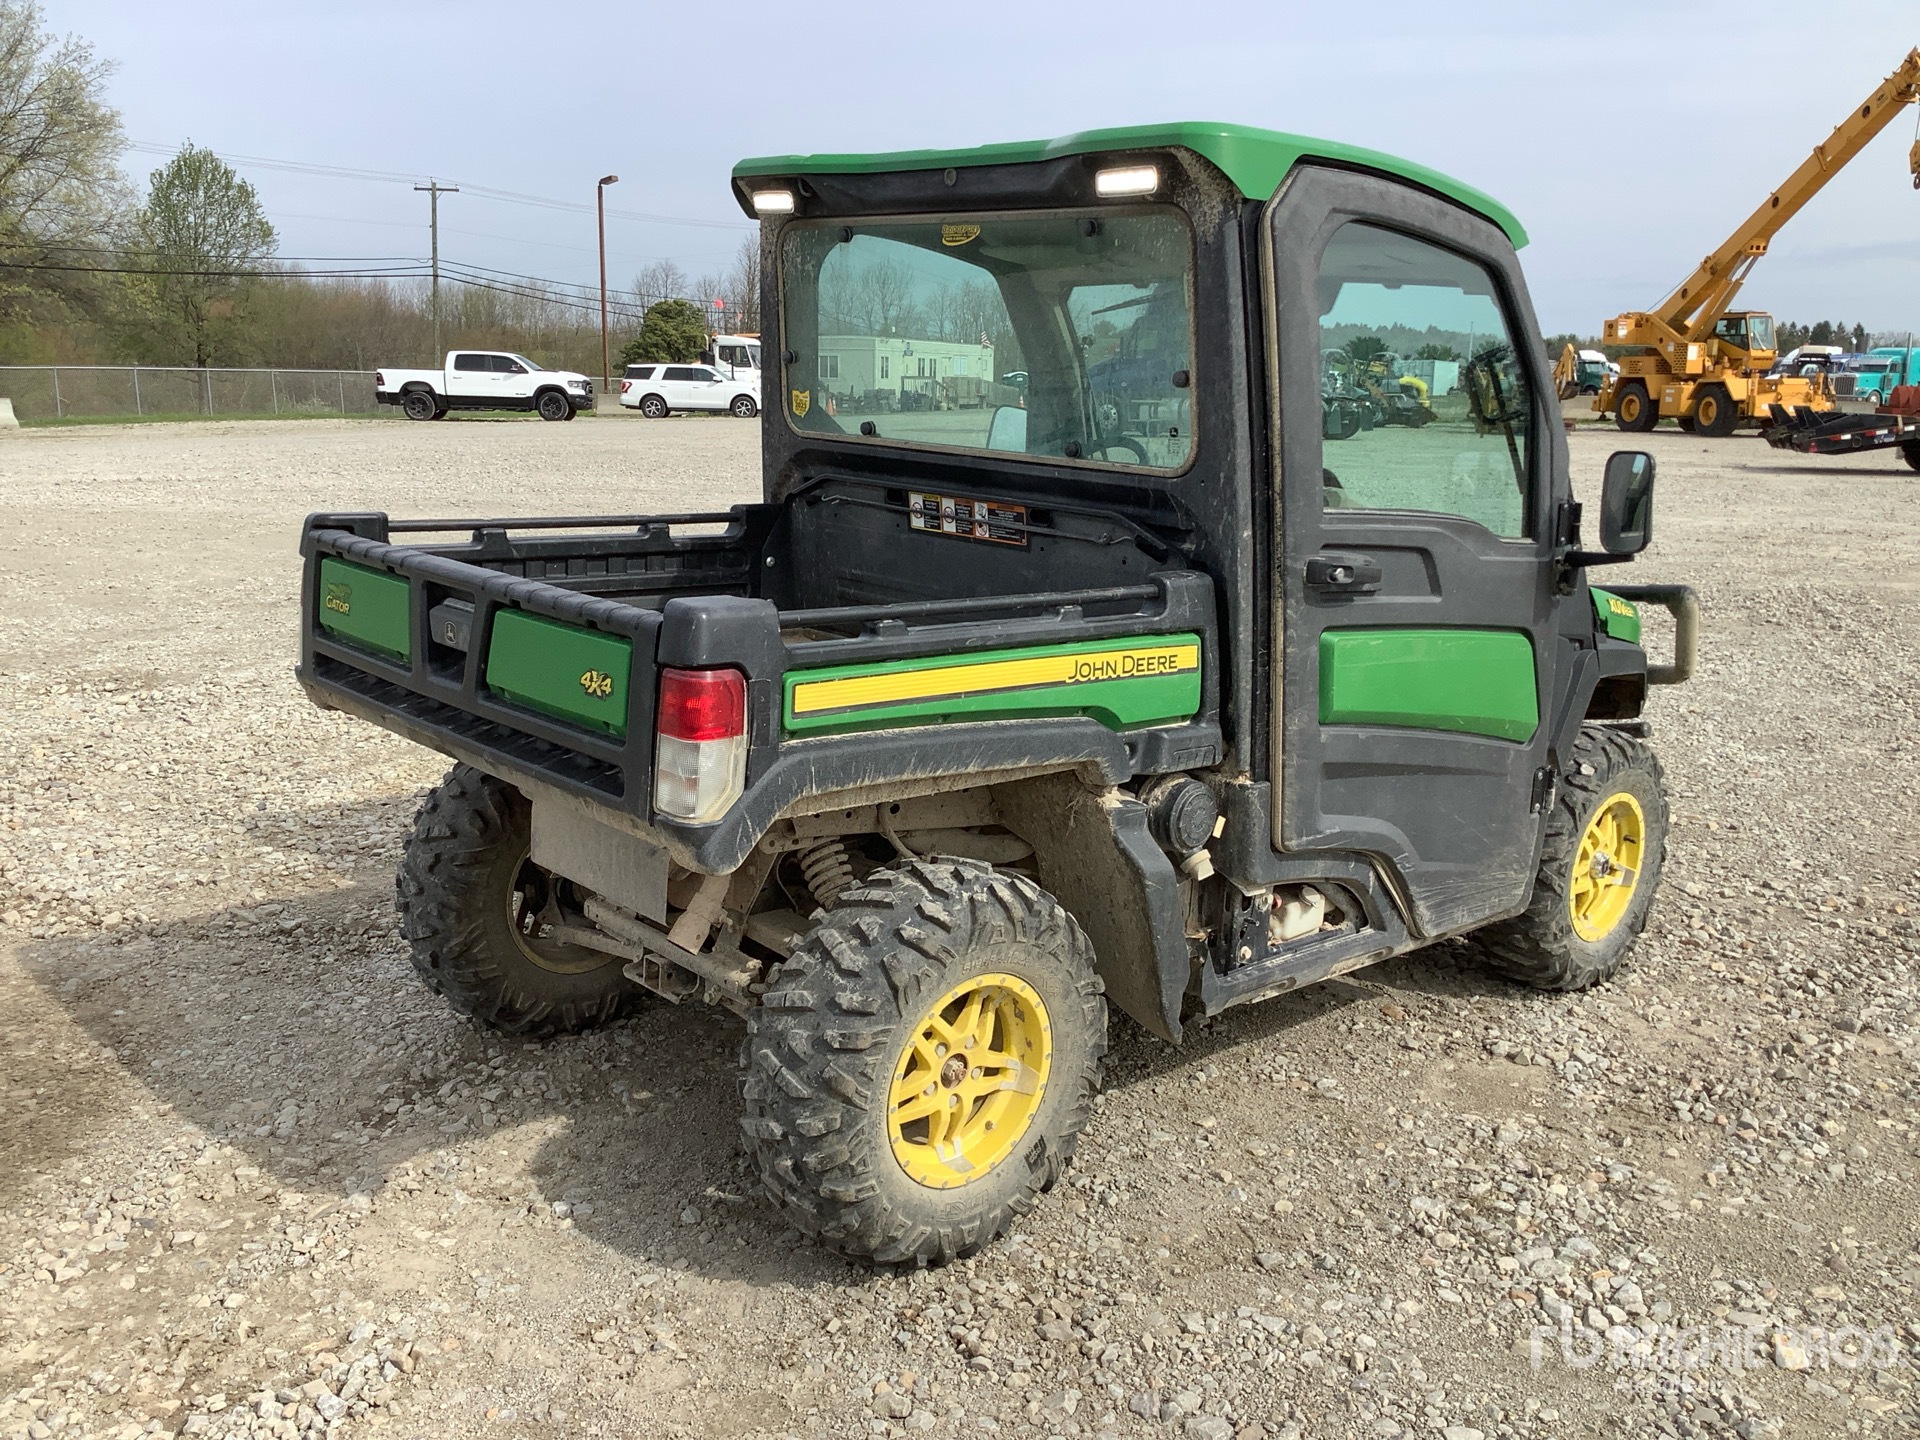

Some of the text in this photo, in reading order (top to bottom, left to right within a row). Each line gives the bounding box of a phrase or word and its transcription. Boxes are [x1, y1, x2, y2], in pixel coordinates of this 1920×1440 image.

[326, 595, 350, 614] GATOR
[1068, 654, 1179, 680] JOHN DEERE
